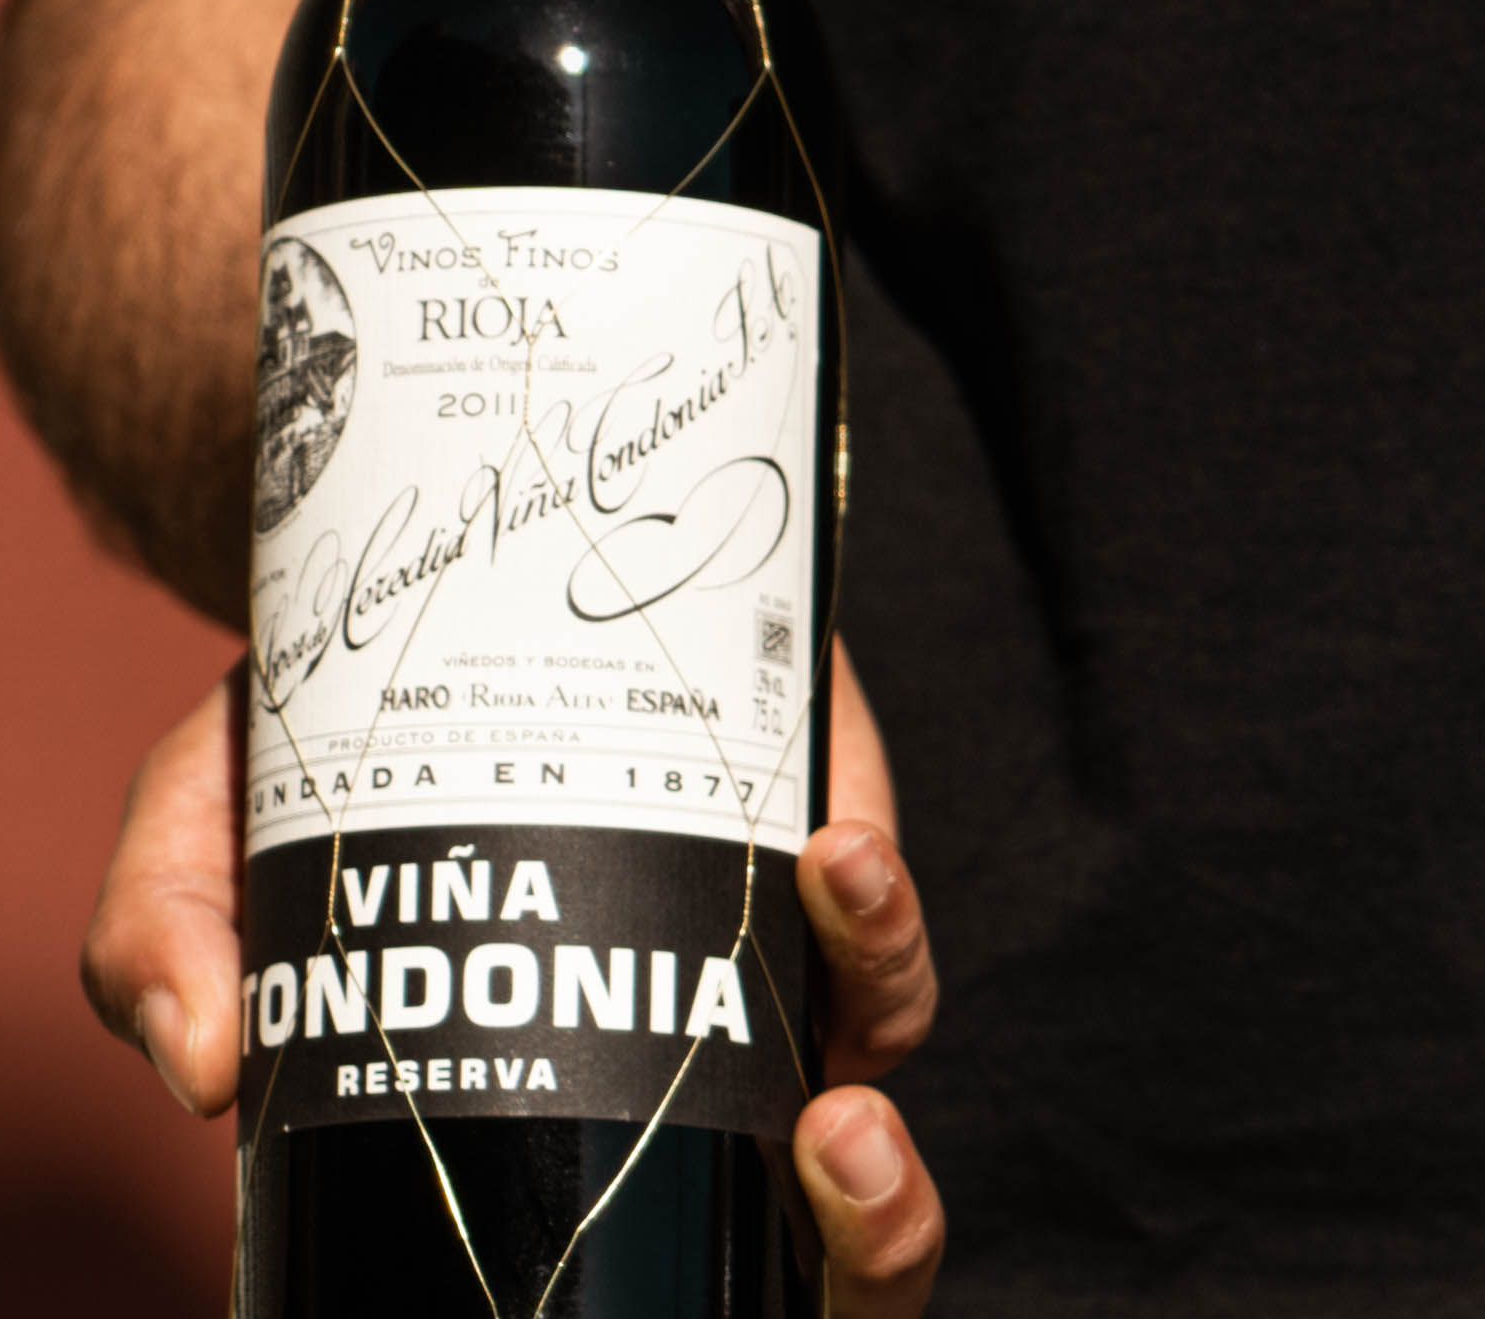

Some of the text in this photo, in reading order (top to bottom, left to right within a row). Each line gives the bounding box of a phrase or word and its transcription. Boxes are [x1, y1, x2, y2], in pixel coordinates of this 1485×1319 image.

[349, 229, 620, 274] VINOS FINOS
[417, 296, 568, 346] RIOJA
[489, 352, 532, 374] Orige
[437, 392, 516, 418] 2011
[459, 399, 577, 567] Viña
[566, 352, 730, 514] Tondonia
[443, 652, 516, 669] VIÑEDOS
[543, 655, 625, 672] BODEGAS
[635, 661, 656, 673] EN
[378, 683, 451, 713] HARO
[626, 688, 721, 721] ESPAÑA
[328, 728, 582, 753] PRODUCTO DE ESPAÑA
[245, 762, 754, 816] UNDADA EN 1877
[341, 843, 560, 928] VIÑA
[241, 942, 752, 1056] TONDONIA
[336, 1056, 558, 1098] RESERVA
